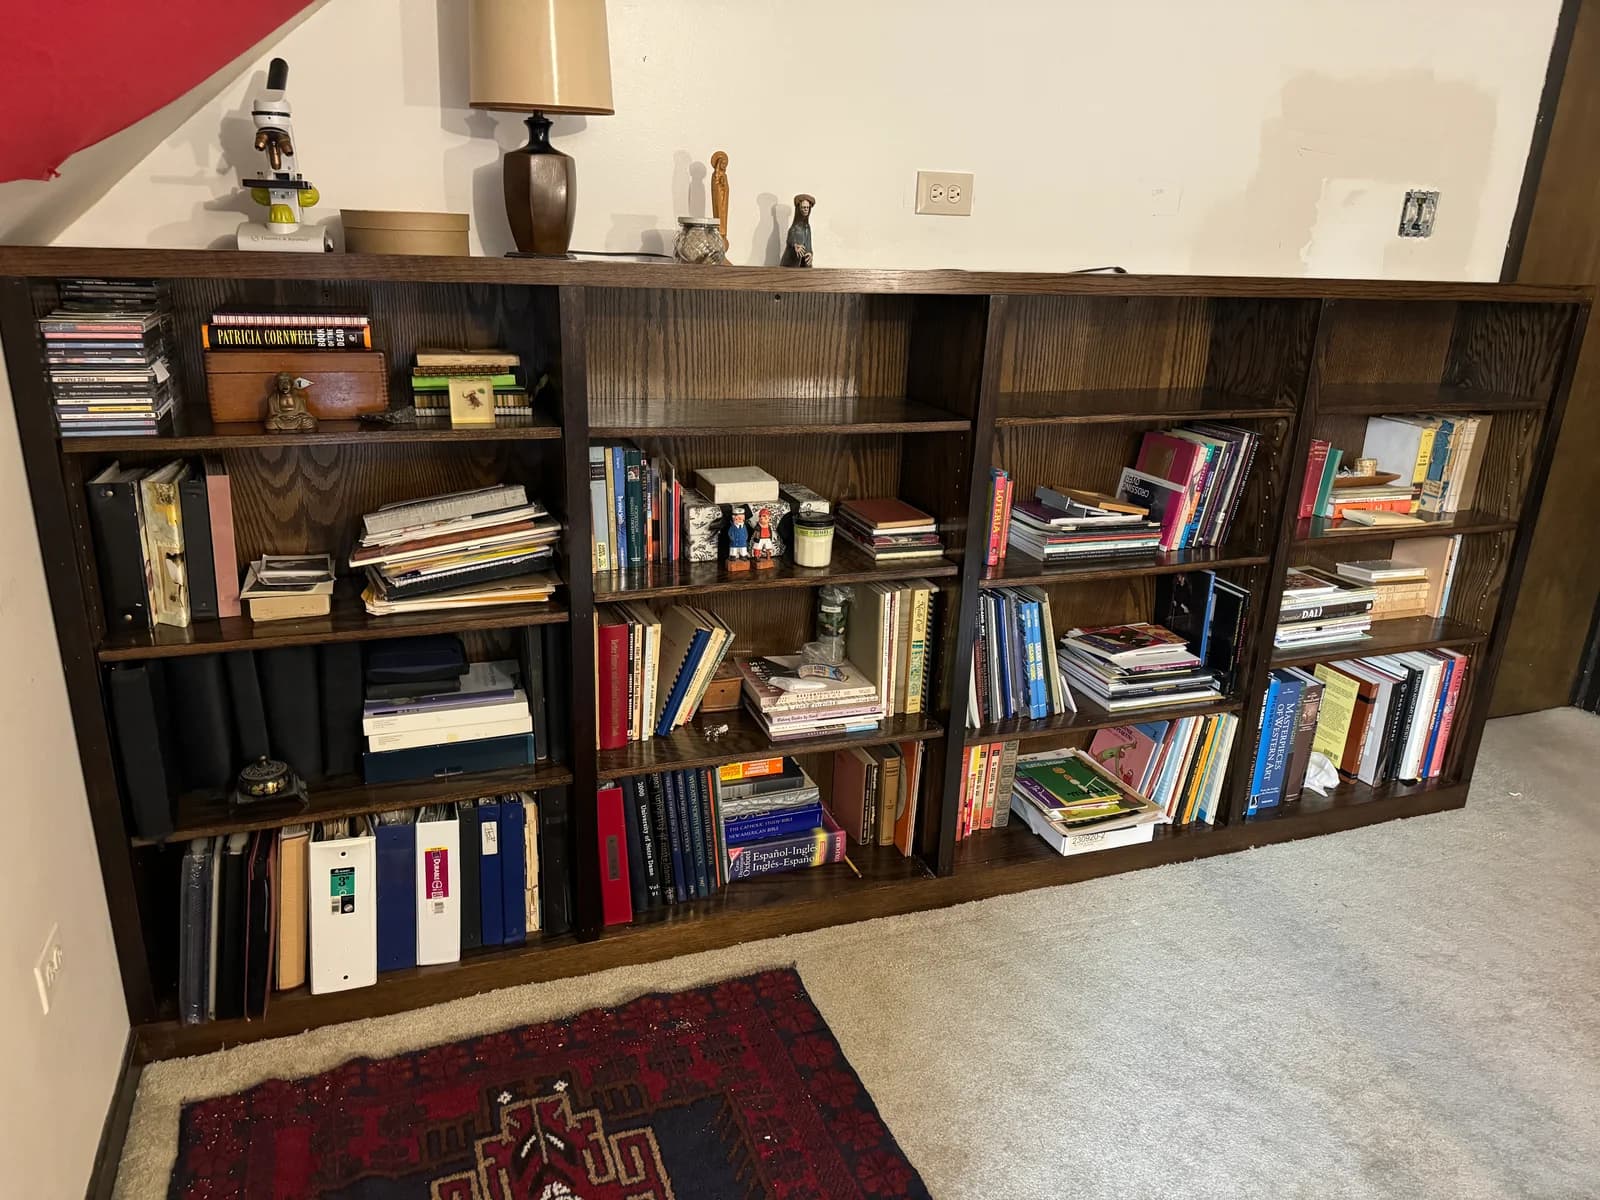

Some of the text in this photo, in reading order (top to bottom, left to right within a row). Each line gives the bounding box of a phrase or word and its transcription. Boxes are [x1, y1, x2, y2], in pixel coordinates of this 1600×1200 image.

[217, 329, 316, 345] PATRICIA CORNWELL
[317, 328, 326, 347] BOOK
[336, 329, 345, 347] DEAD
[1124, 472, 1141, 485] OVER
[1121, 481, 1150, 498] CROSSING
[1263, 702, 1286, 781] OF WESTERN ART
[1274, 701, 1295, 771] MASTERPIECES
[688, 775, 697, 804] WHEATON
[641, 804, 650, 834] University
[646, 842, 654, 859] Notre
[740, 828, 766, 838] AMERICAN
[767, 826, 779, 834] BIBLE
[752, 854, 816, 872] Inglés-Españo
